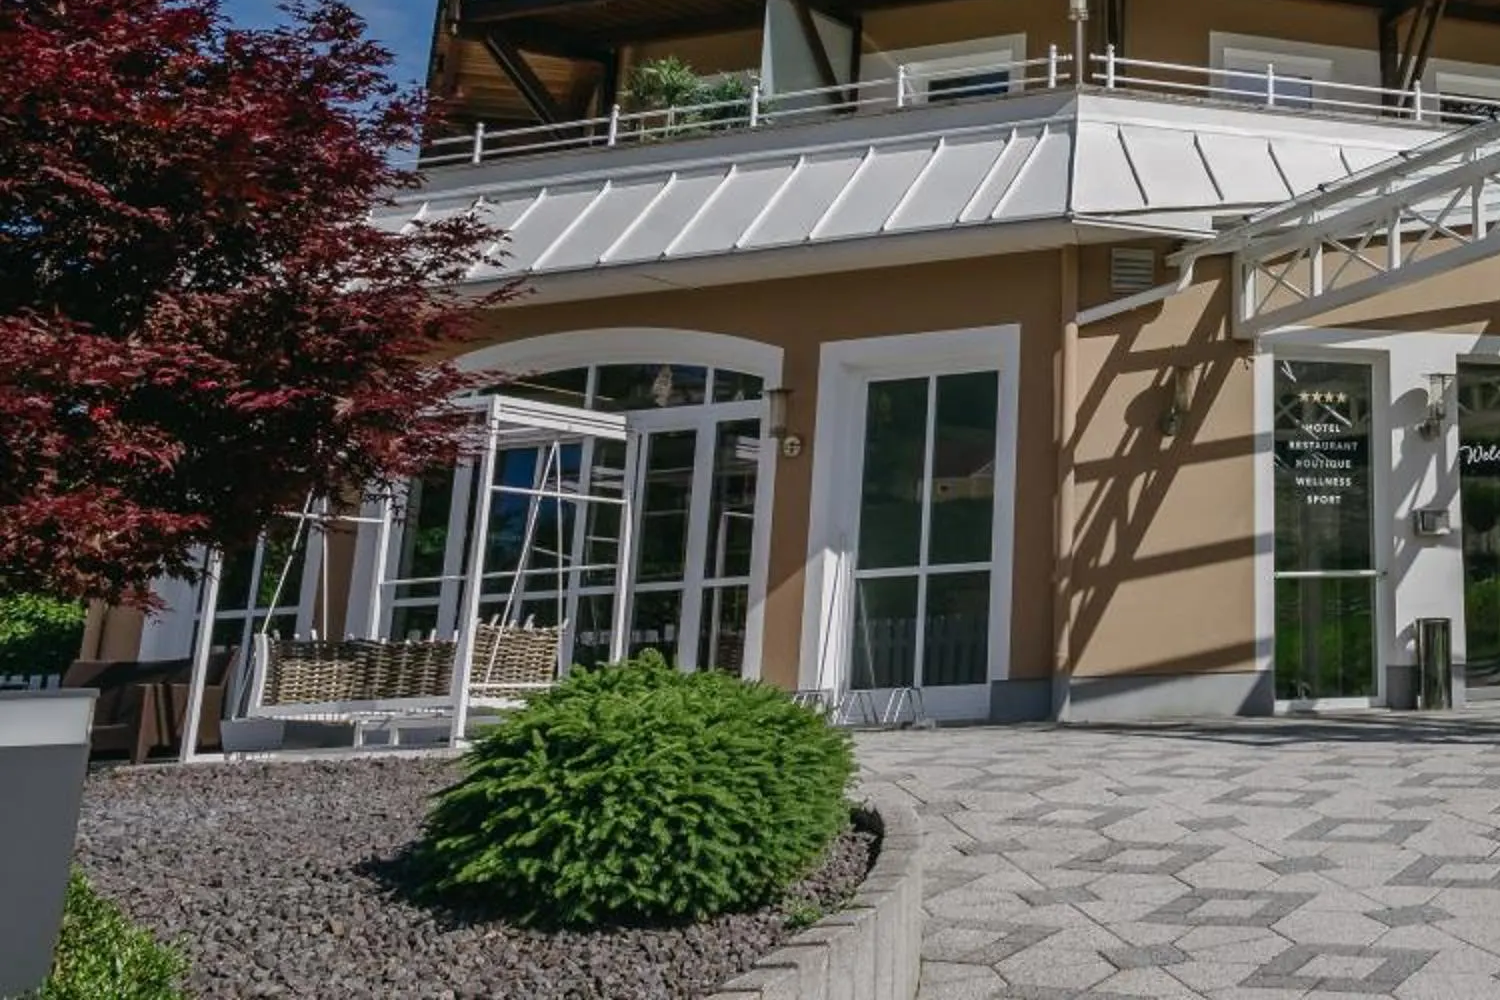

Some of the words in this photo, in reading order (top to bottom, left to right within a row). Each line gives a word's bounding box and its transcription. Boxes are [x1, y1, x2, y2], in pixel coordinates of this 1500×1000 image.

[1303, 423, 1341, 433] HOTEL
[1289, 441, 1359, 451] RESTAURANT
[1295, 459, 1352, 469] BOUTIQUE
[1295, 476, 1352, 487] WELLNESS
[1306, 495, 1342, 505] SPORT
